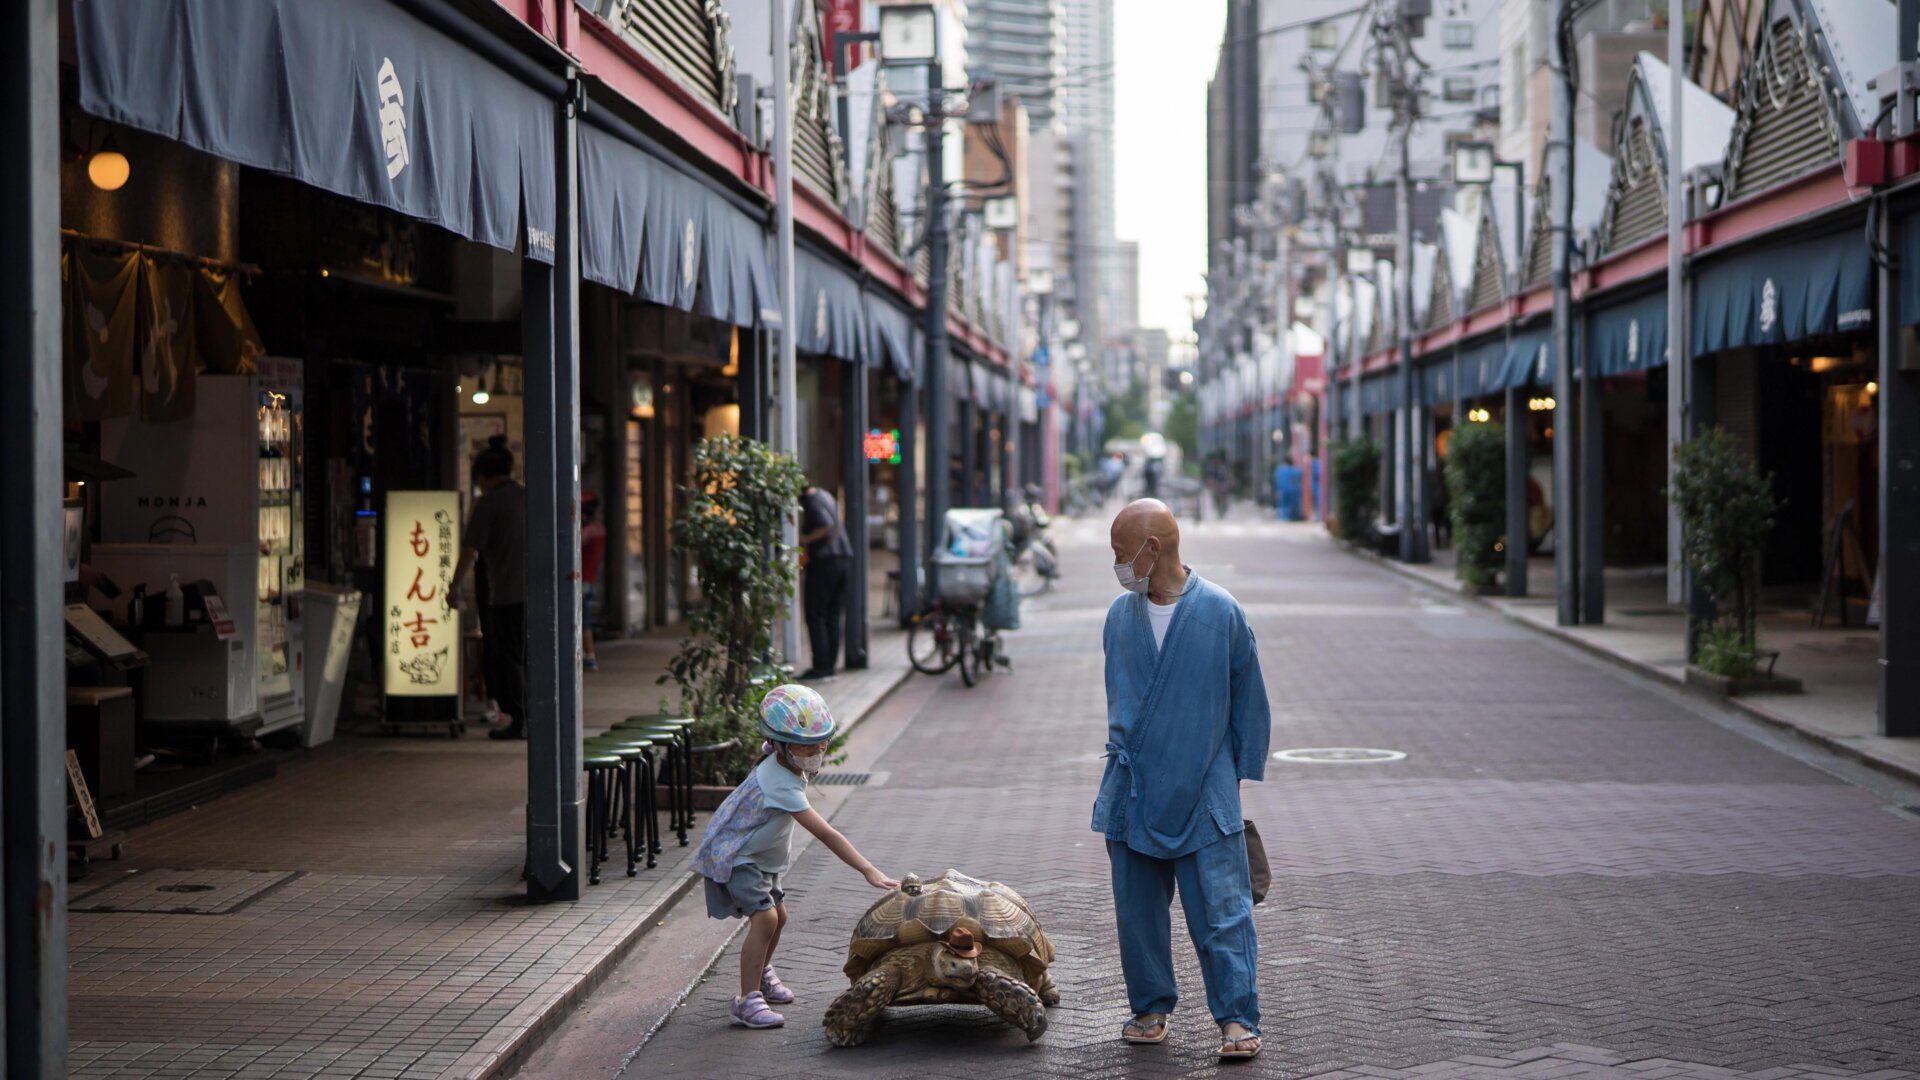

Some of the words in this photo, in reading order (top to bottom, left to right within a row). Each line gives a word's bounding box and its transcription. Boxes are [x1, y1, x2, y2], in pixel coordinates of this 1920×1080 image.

[138, 496, 207, 508] MONJA
[403, 520, 438, 648] もん吉
